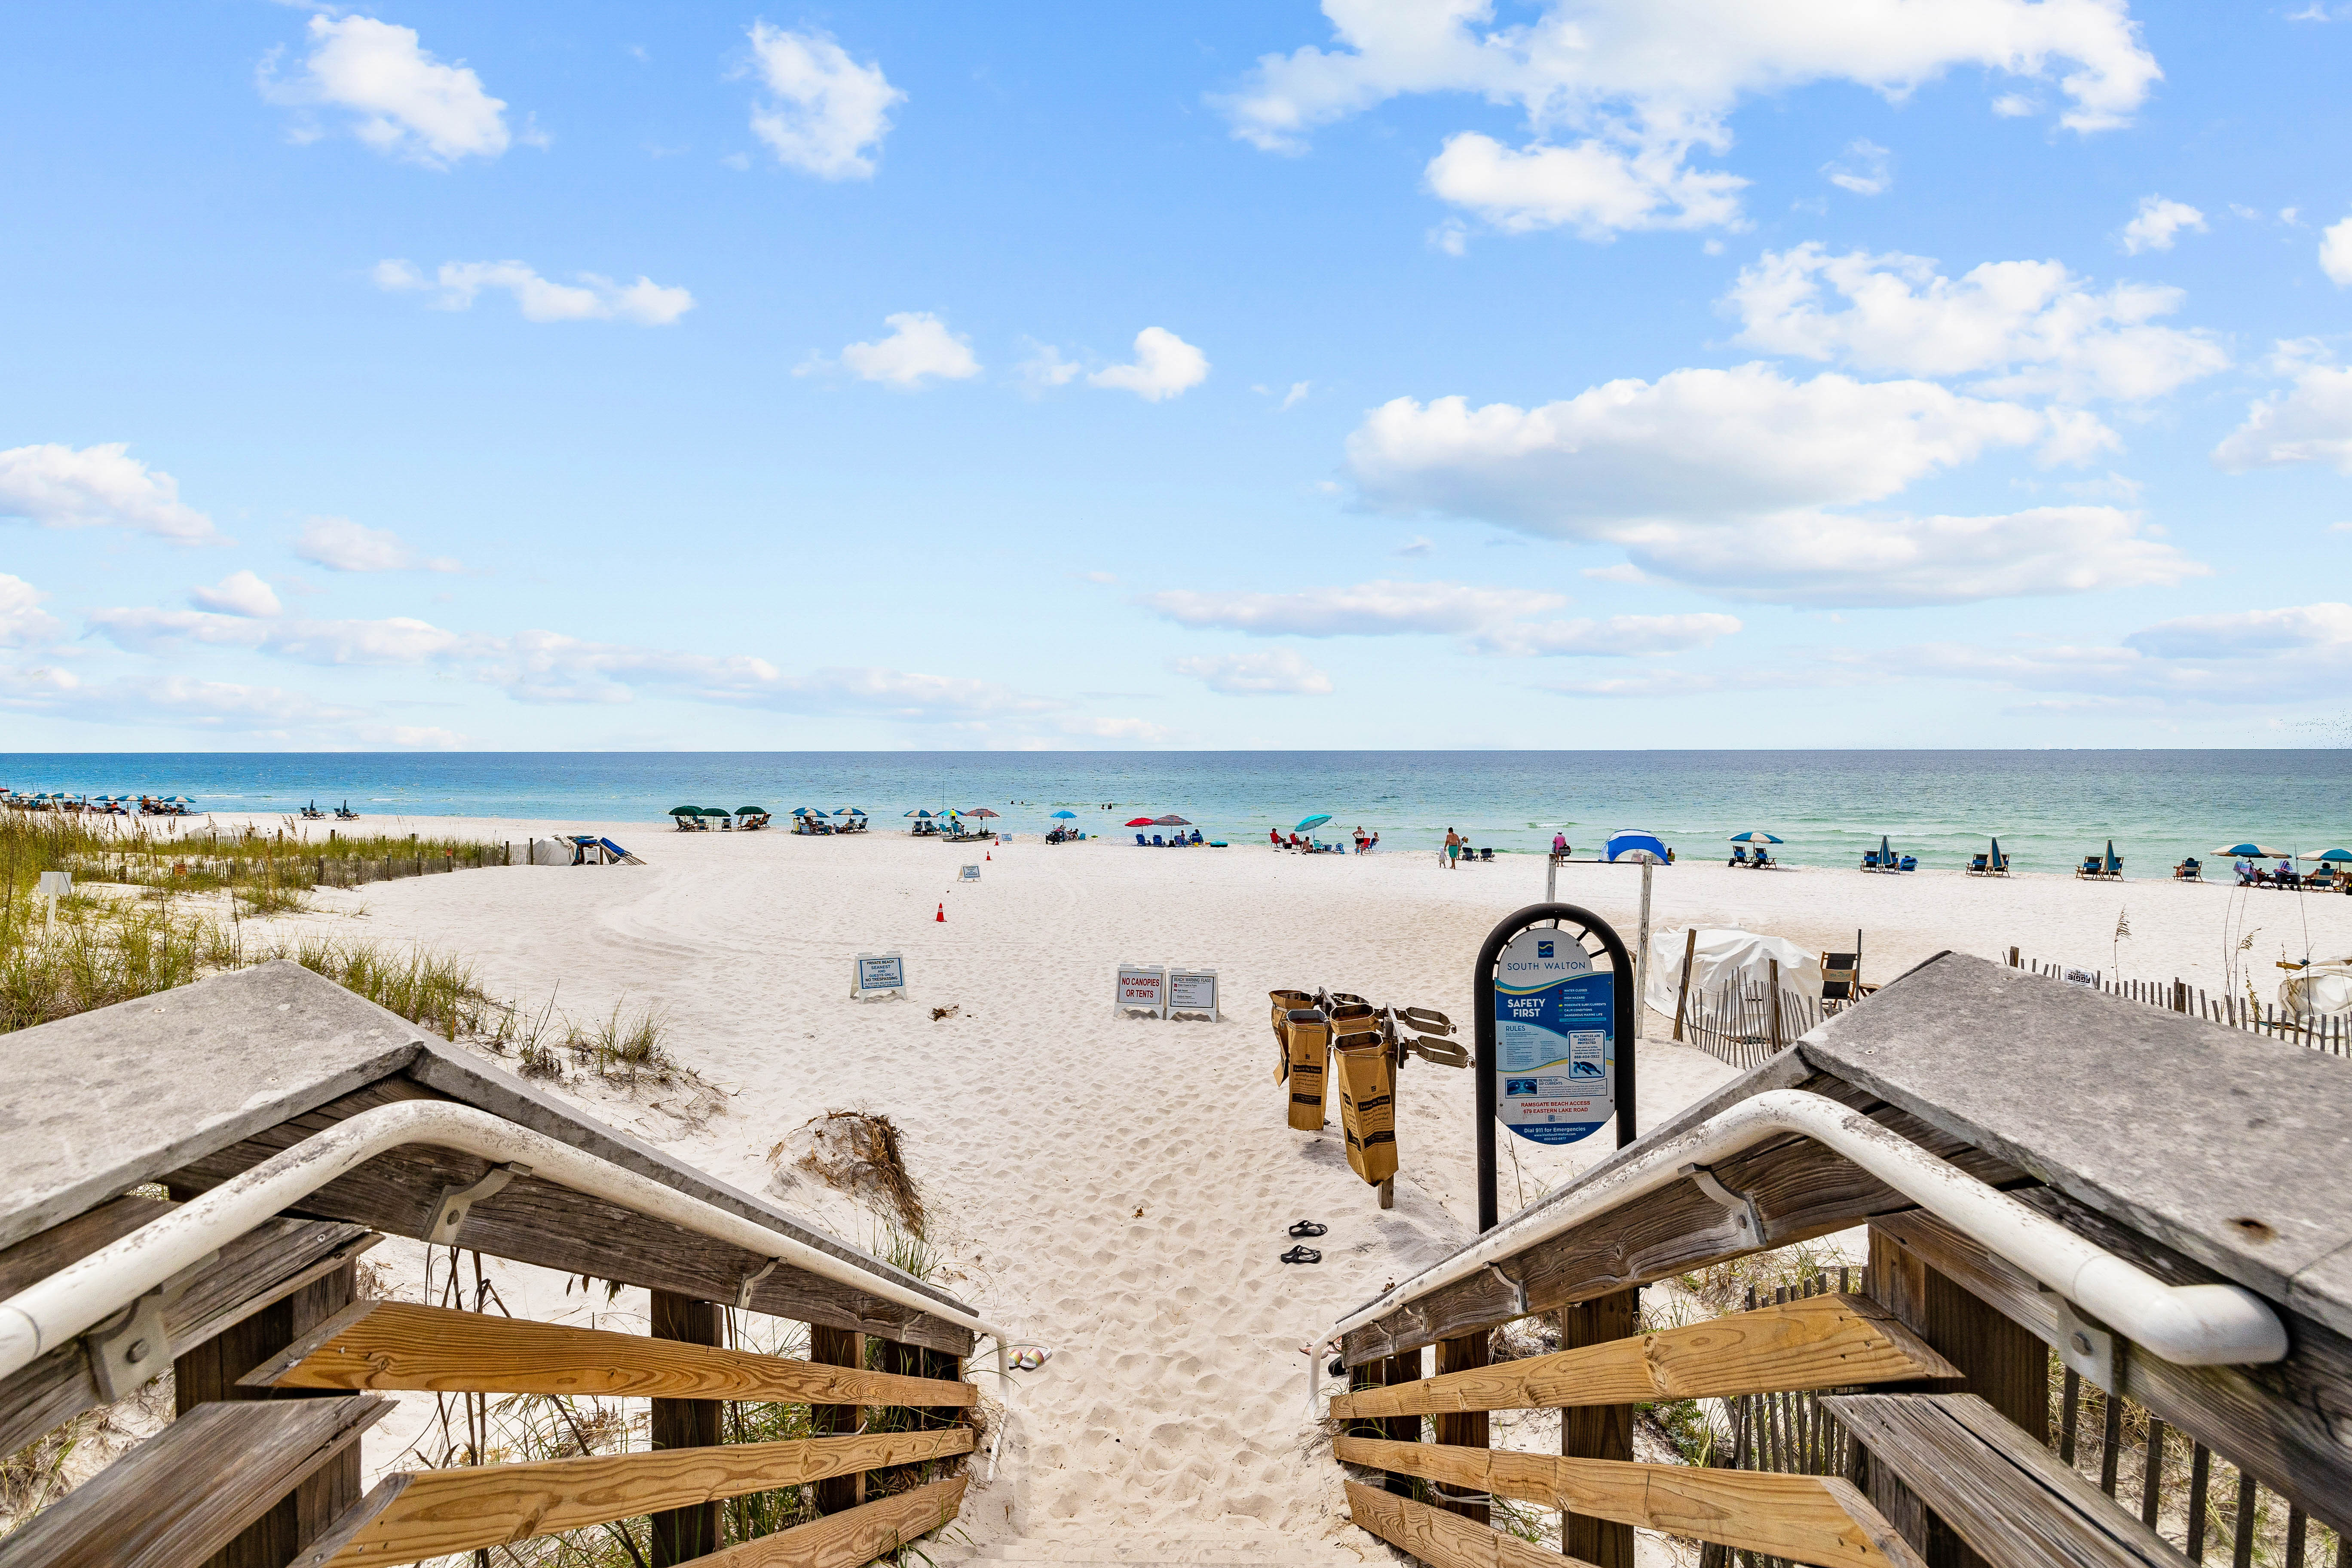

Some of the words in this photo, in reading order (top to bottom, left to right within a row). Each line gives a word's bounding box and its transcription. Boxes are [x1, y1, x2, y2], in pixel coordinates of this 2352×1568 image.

[1507, 962, 1539, 971] SOUTH
[1544, 962, 1586, 970] WALTON
[1121, 977, 1130, 985] NO
[1131, 977, 1160, 987] CANOPIES
[2067, 974, 2091, 983] AGGIE
[1126, 989, 1134, 997] OR
[1136, 989, 1154, 998] TENTS
[1507, 998, 1545, 1008] SAFETY
[1513, 1008, 1540, 1017] FIRST
